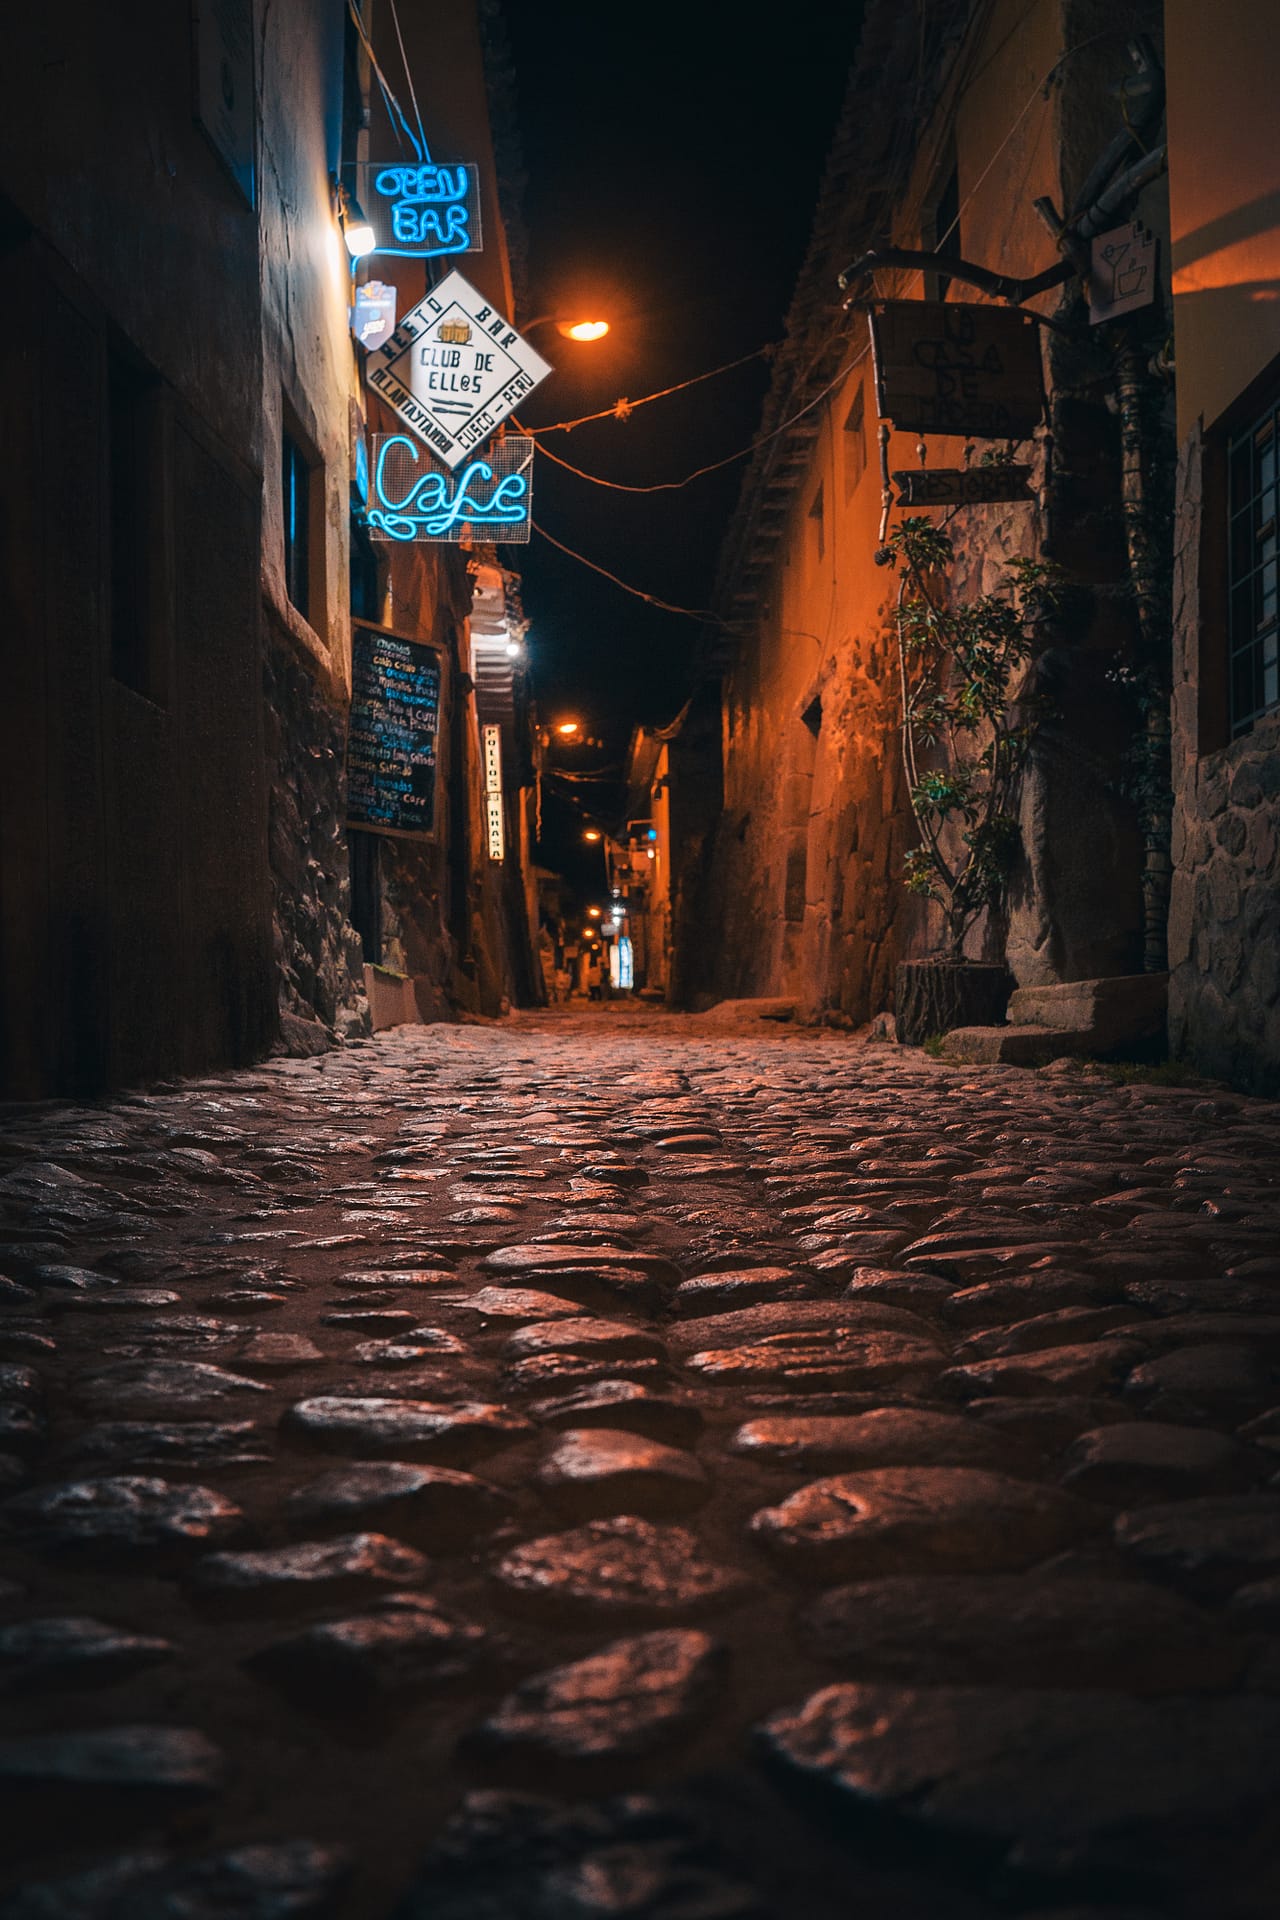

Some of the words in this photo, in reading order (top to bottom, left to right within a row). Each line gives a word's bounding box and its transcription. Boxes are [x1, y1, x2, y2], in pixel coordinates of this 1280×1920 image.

[375, 165, 468, 200] OPEN
[392, 204, 470, 246] BAR
[380, 297, 443, 359] RESTO
[475, 306, 518, 348] BAR
[421, 347, 460, 367] CLUB
[474, 353, 495, 372] DE
[429, 371, 482, 394] ELL@S
[457, 412, 495, 450] CUSCO
[502, 373, 535, 406] PERU
[488, 729, 498, 786] POLLOS
[490, 810, 500, 857] BRASA
